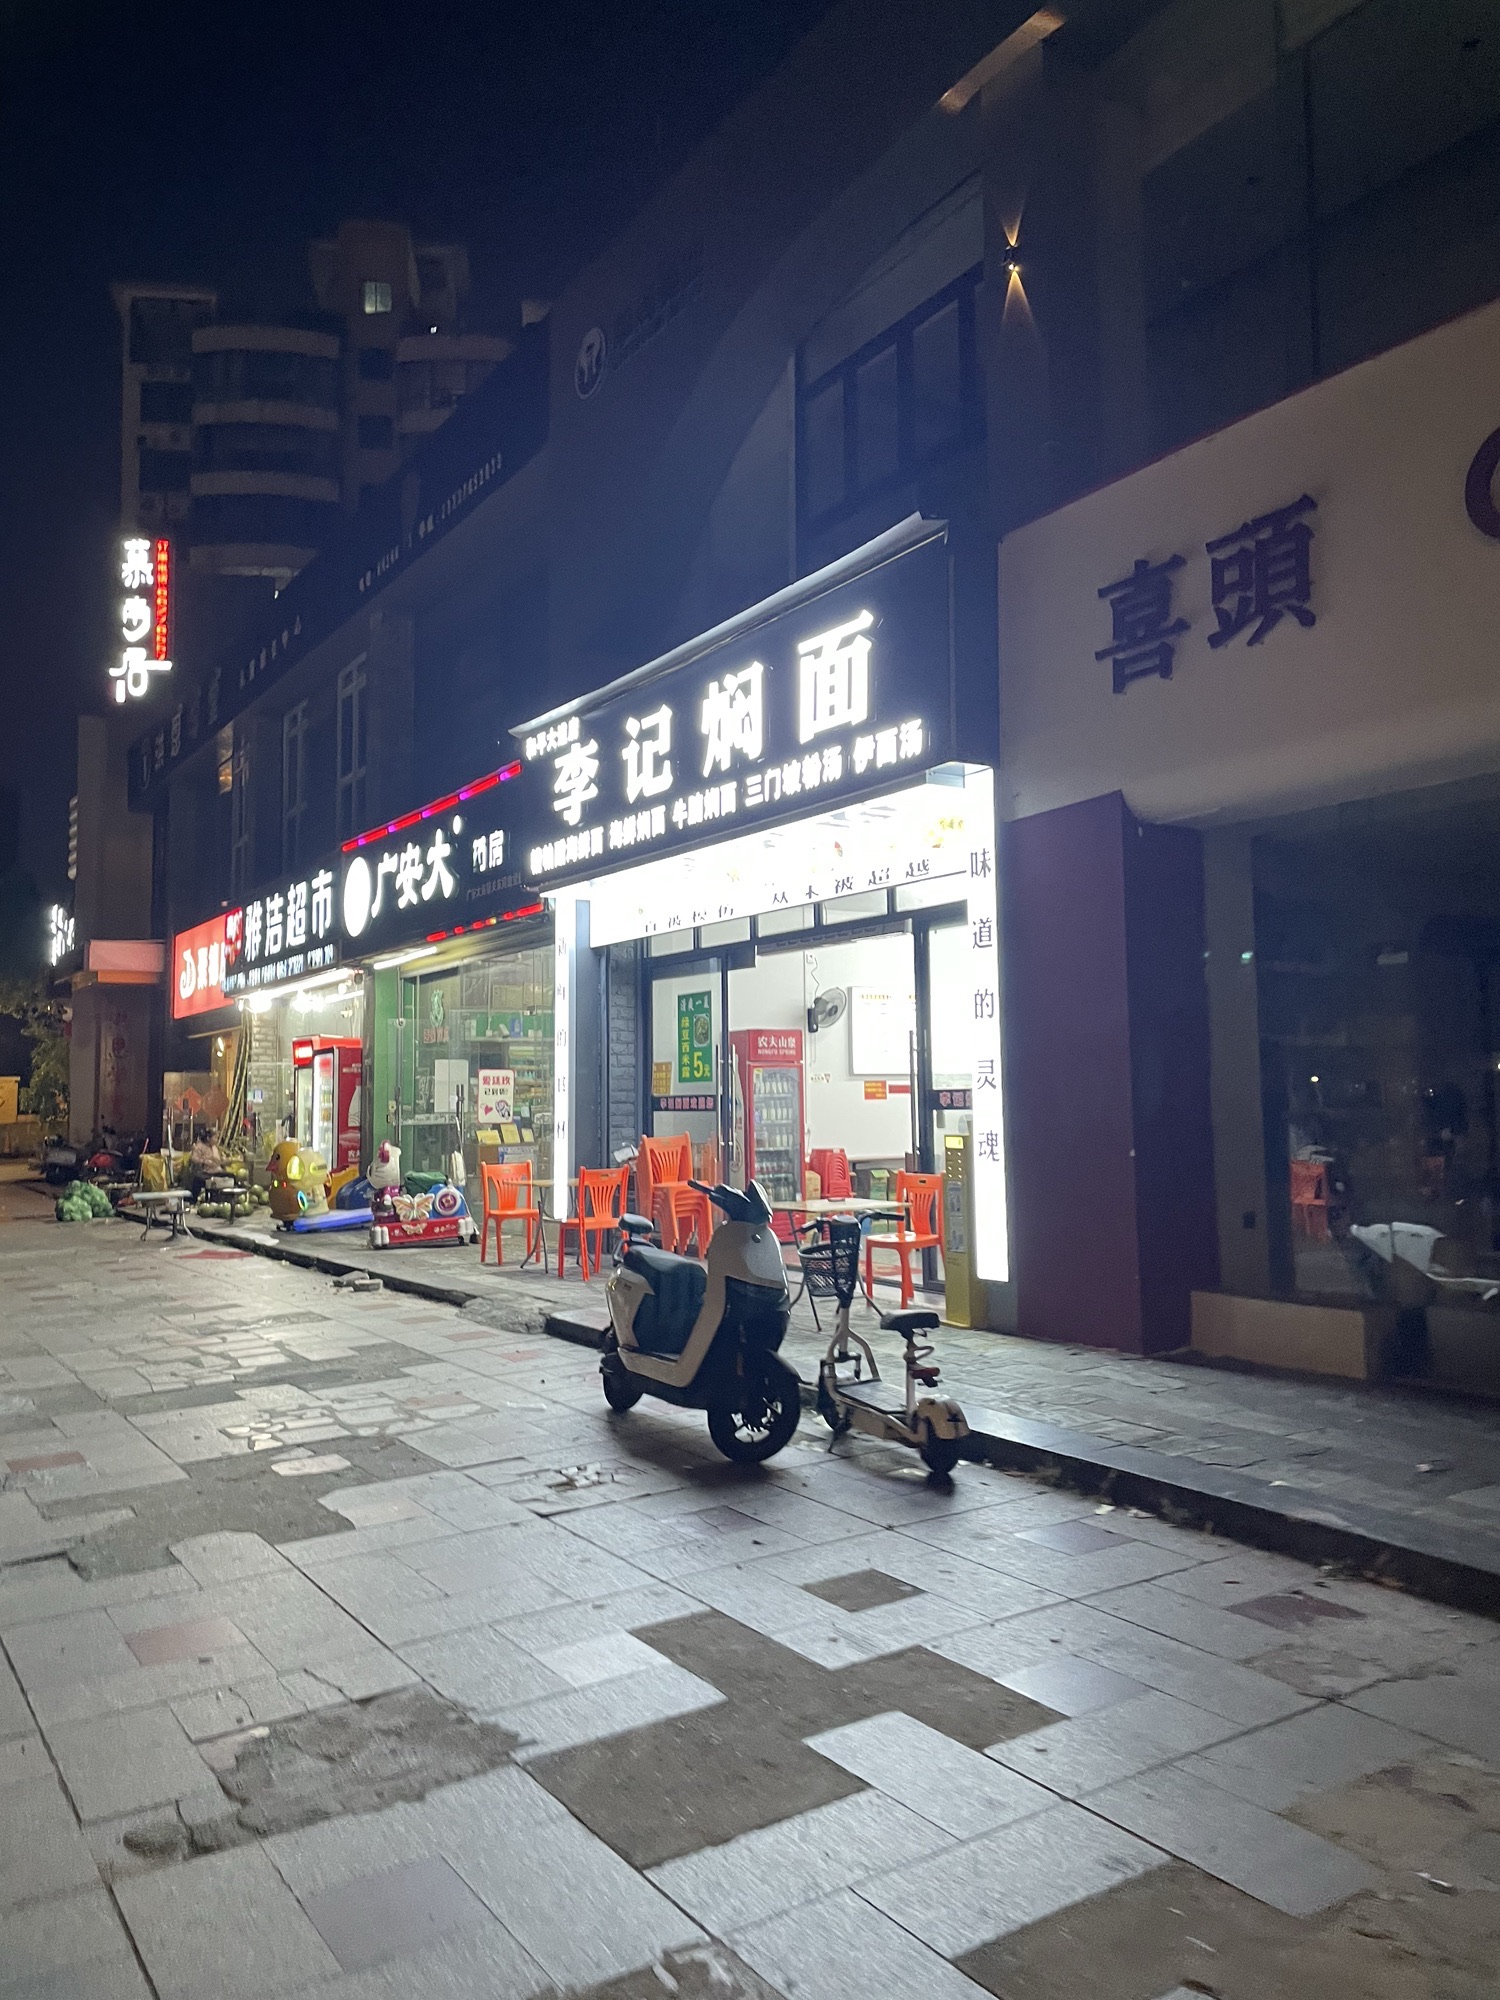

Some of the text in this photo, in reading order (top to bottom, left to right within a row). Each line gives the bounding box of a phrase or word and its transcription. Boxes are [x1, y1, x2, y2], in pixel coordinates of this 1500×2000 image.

[553, 609, 874, 826] 李记焖面
[853, 718, 923, 774] 伊面汤
[244, 868, 333, 962] 雅洁超市
[758, 1036, 796, 1049] 农夫山泉
[970, 847, 1000, 1161] 味道的灵魂
